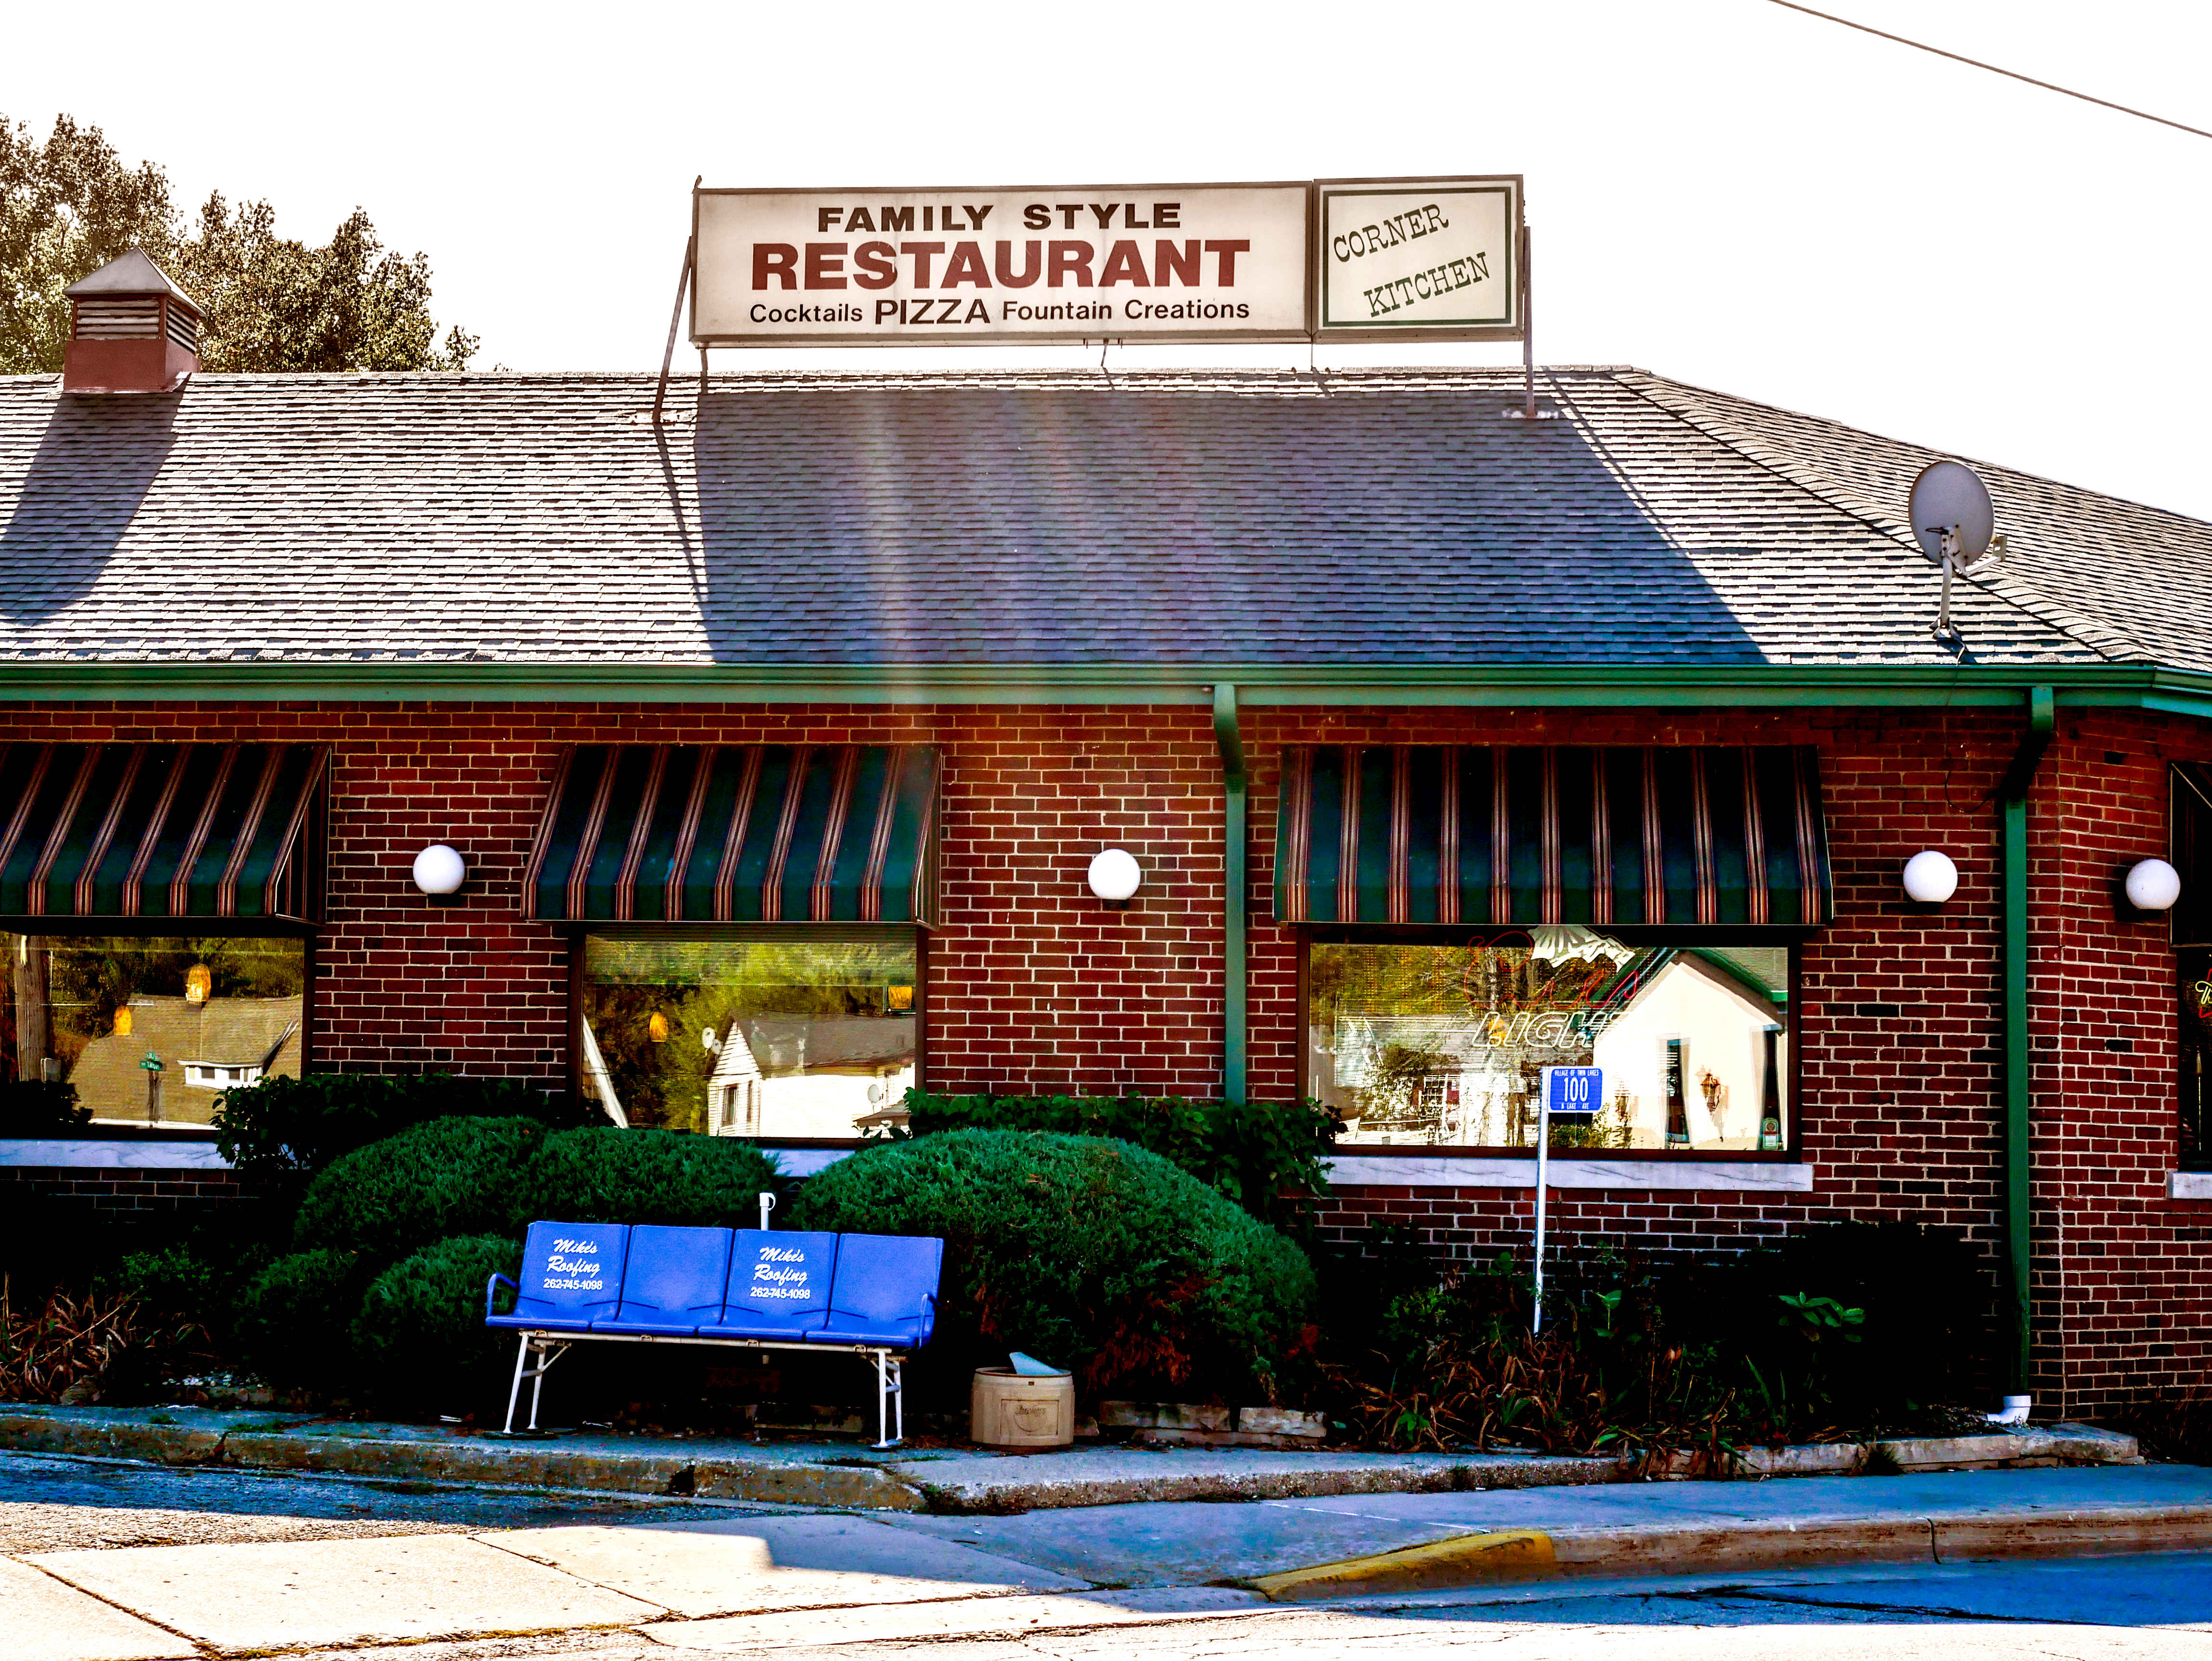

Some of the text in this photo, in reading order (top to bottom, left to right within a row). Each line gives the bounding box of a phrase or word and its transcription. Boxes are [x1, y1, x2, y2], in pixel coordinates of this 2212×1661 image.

[818, 203, 1180, 232] FAMILY STYLE
[1334, 204, 1448, 262] CORNER
[752, 240, 1250, 290] RESTAURANT
[1364, 251, 1489, 317] KITCHEN
[750, 299, 1249, 324] Cocktails PIZZA Fountain Creations
[1564, 1077, 1588, 1102] 100
[553, 1239, 597, 1253] Mike's
[760, 1247, 805, 1262] Mike's
[546, 1255, 600, 1278] Roofing
[753, 1264, 808, 1287] Roofing
[543, 1278, 603, 1290] 262-745-1098
[750, 1287, 811, 1299] 262-745-1098
